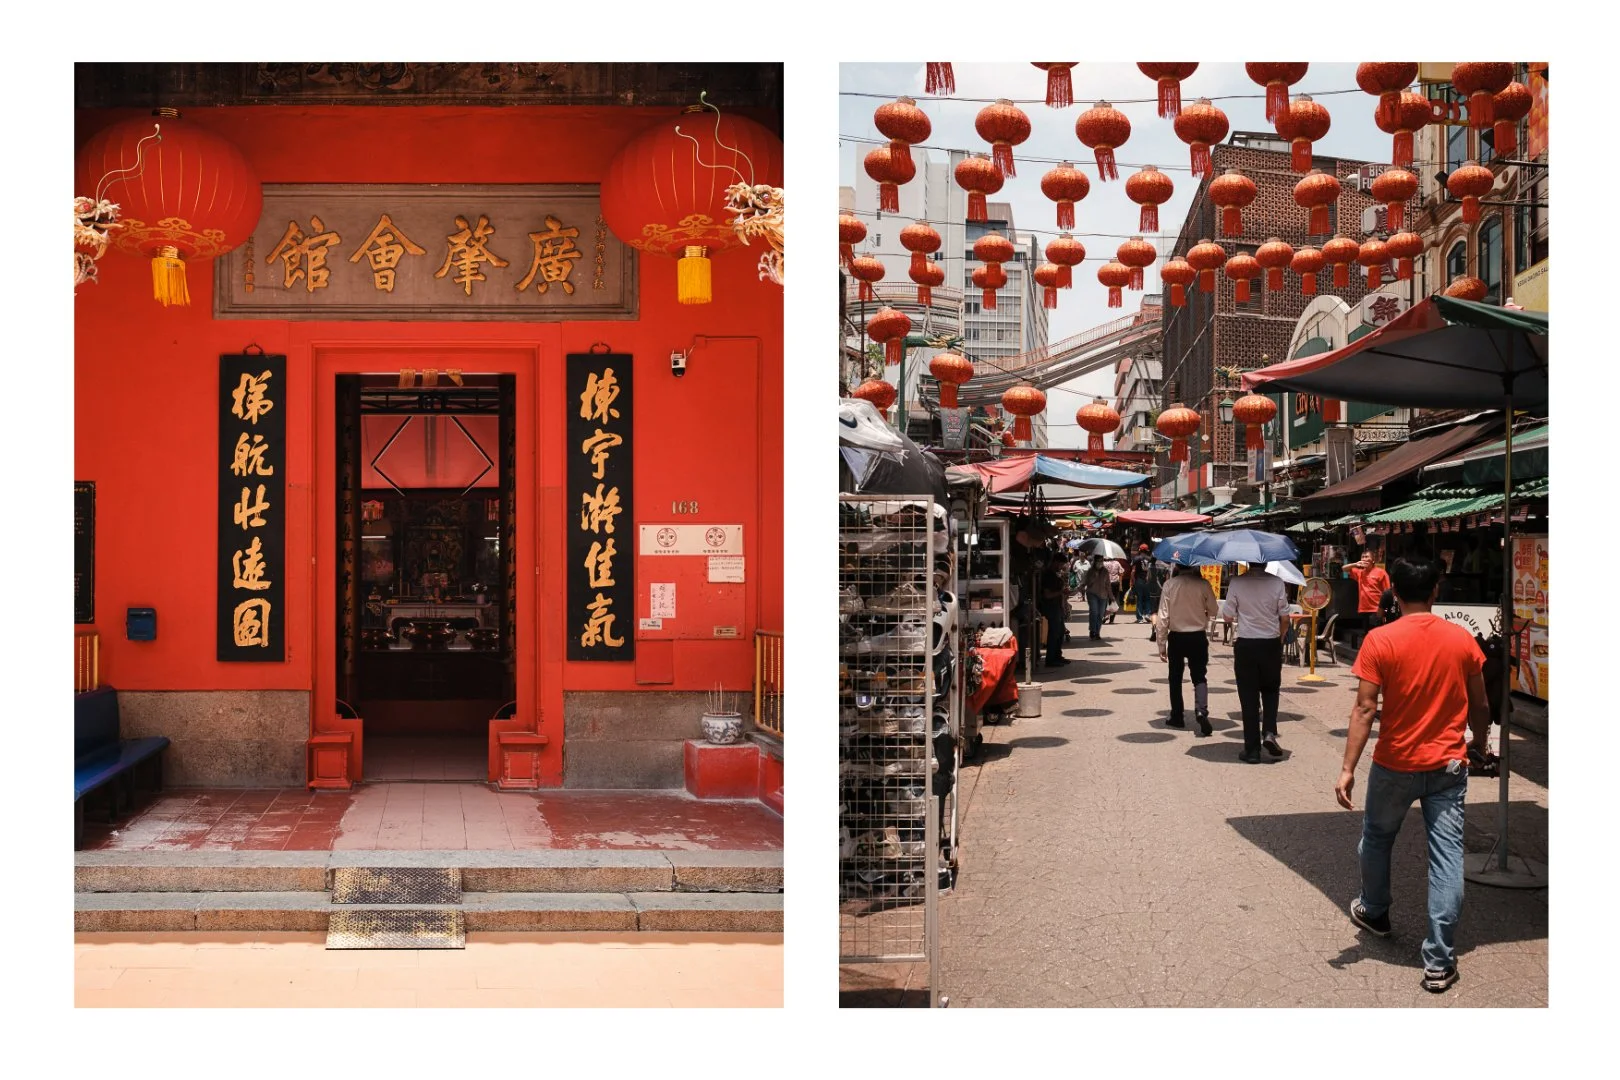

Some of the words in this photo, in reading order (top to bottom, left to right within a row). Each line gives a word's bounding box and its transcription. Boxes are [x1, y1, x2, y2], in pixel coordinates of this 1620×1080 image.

[265, 213, 583, 297] 廣肇會館
[671, 500, 699, 514] 168
[1444, 611, 1480, 632] ALOGUE
